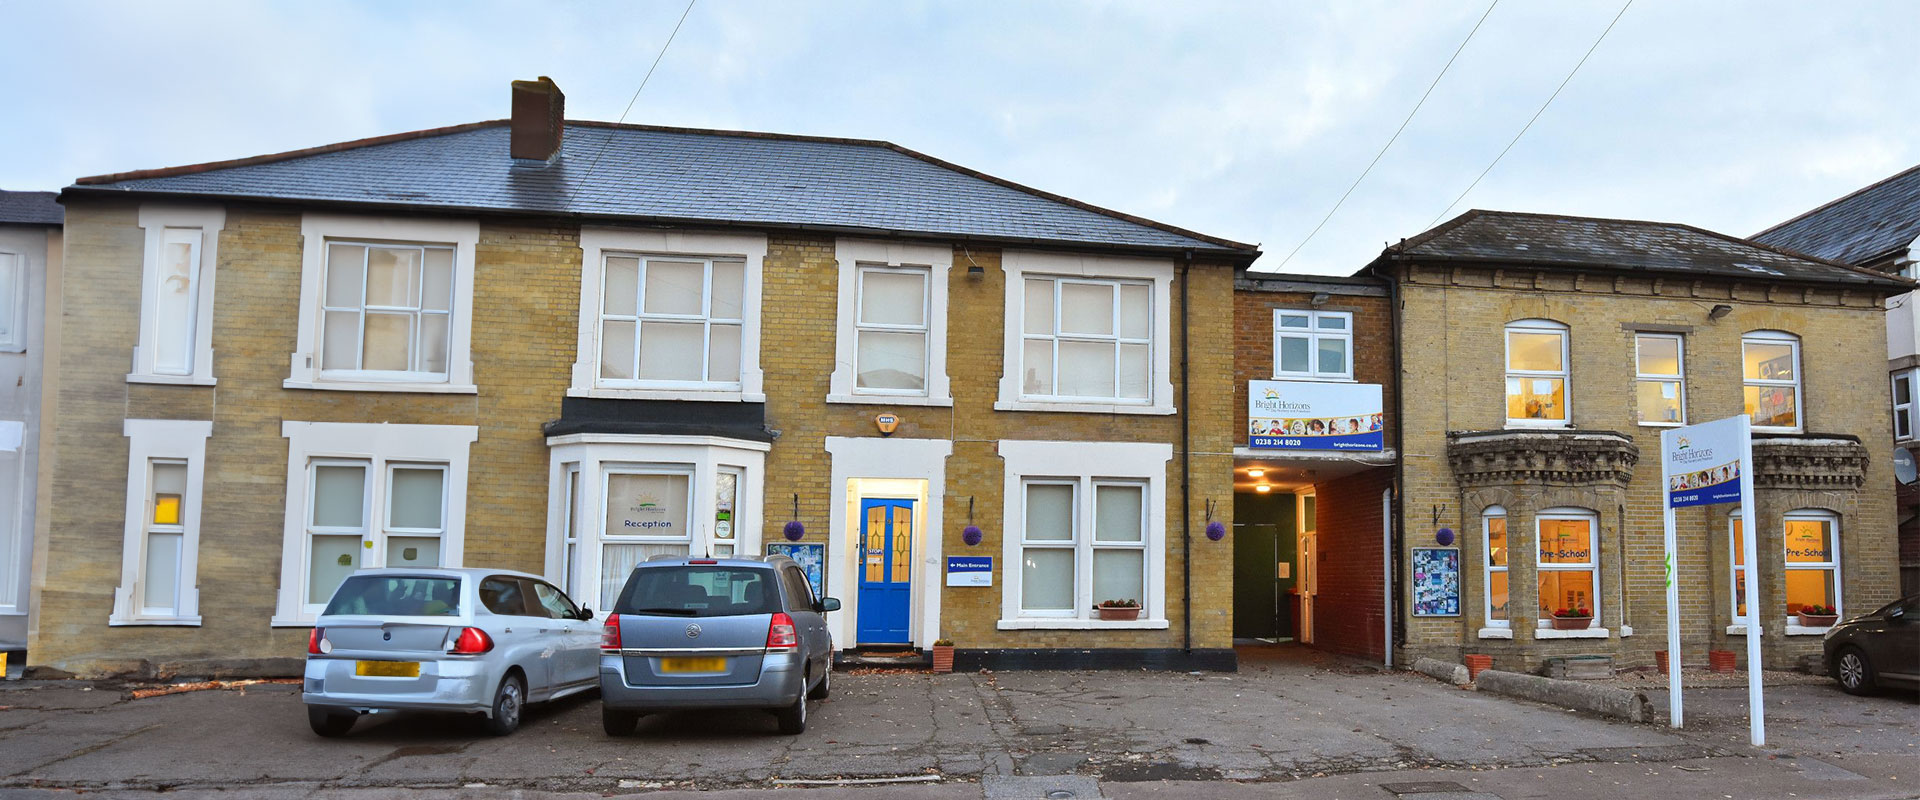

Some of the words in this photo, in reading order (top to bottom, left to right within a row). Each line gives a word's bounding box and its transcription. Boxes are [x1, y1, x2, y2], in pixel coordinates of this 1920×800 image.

[1255, 400, 1277, 411] Bright
[1279, 401, 1311, 410] Horizons
[1672, 450, 1688, 461] Bright
[1689, 448, 1713, 459] Horizons
[624, 519, 672, 529] Reception
[1539, 549, 1588, 558] Pre-School
[1786, 548, 1829, 557] Pre-School
